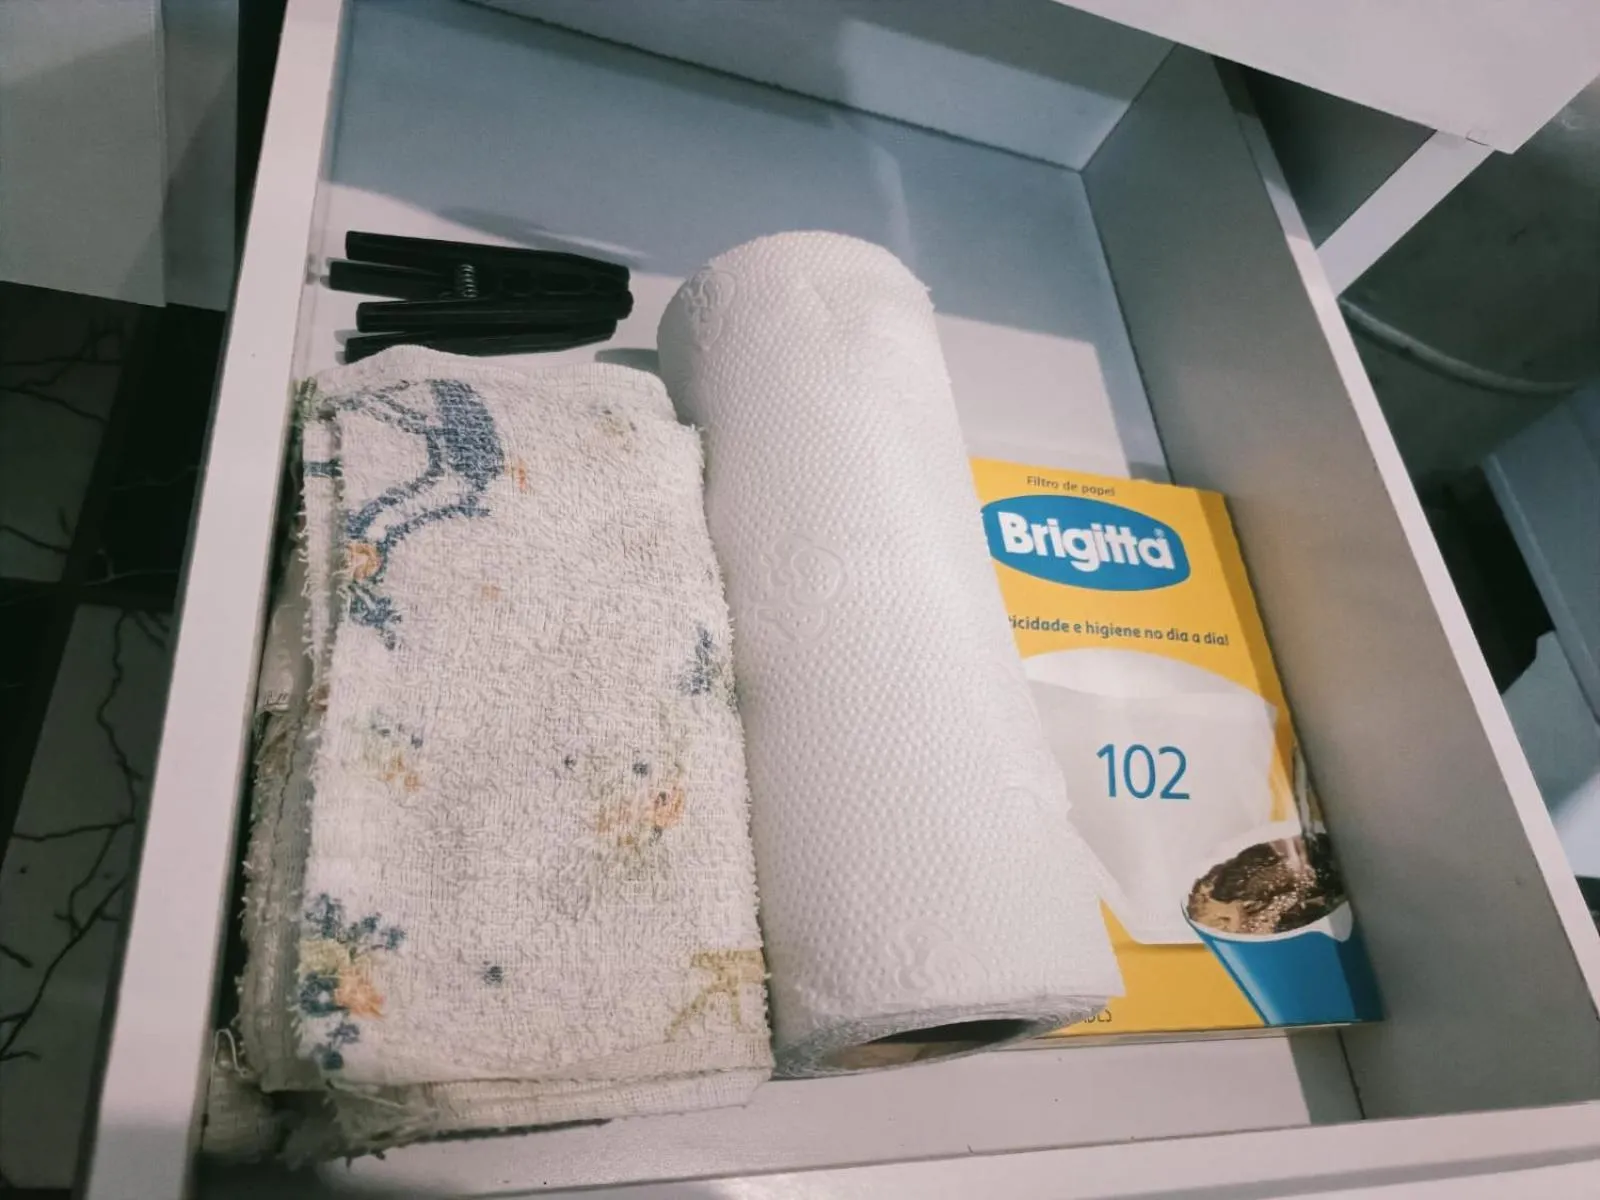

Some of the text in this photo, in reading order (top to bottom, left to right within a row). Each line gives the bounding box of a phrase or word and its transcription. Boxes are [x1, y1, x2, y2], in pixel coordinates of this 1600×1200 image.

[1026, 475, 1116, 497] Filtro de papel
[997, 511, 1176, 573] Brigitta
[1072, 623, 1083, 634] e
[1085, 620, 1141, 639] higiene
[1144, 628, 1163, 640] no
[1166, 627, 1189, 642] dia
[1191, 632, 1201, 643] a
[1203, 631, 1230, 646] dia!
[1096, 743, 1190, 800] 102
